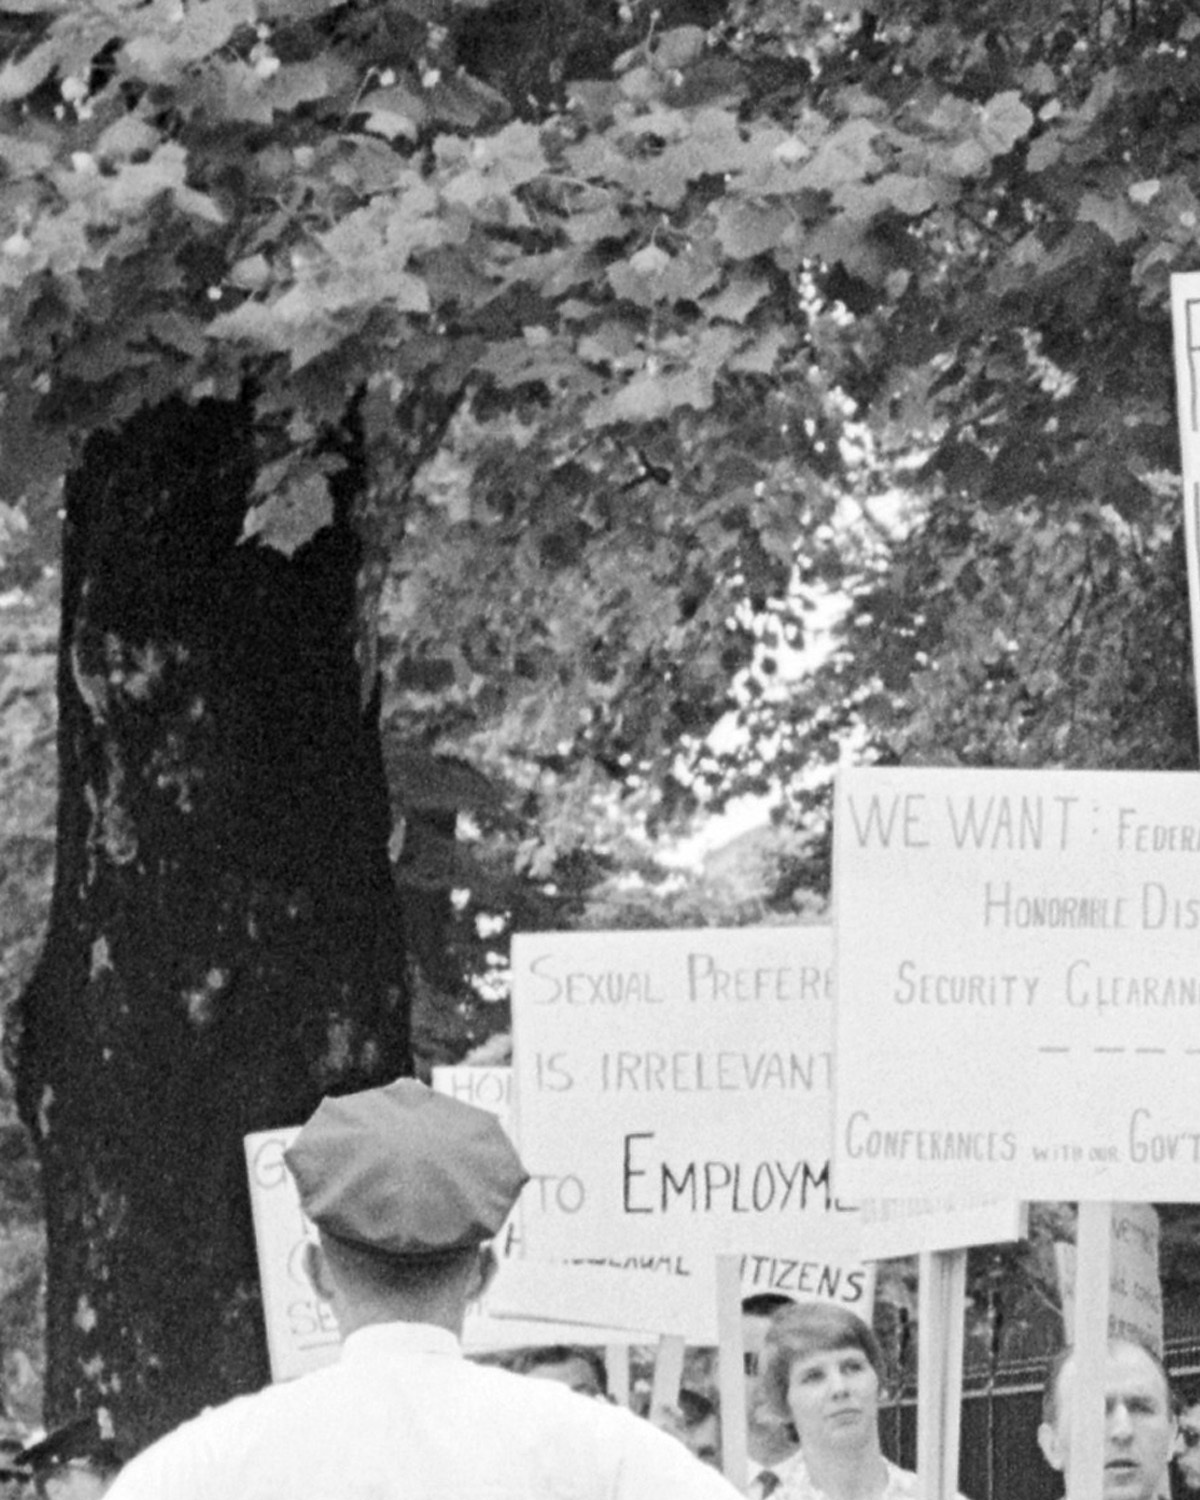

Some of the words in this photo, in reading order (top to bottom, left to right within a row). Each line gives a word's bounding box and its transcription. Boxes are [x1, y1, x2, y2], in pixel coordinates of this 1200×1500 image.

[850, 793, 930, 849] WE
[529, 953, 665, 1005] SEXUAL
[687, 952, 834, 1002] PREFERE
[536, 1051, 574, 1092] IS
[531, 1174, 586, 1214] TO
[622, 1130, 860, 1215] EMPLOYM
[739, 1254, 866, 1302] ITIZENS
